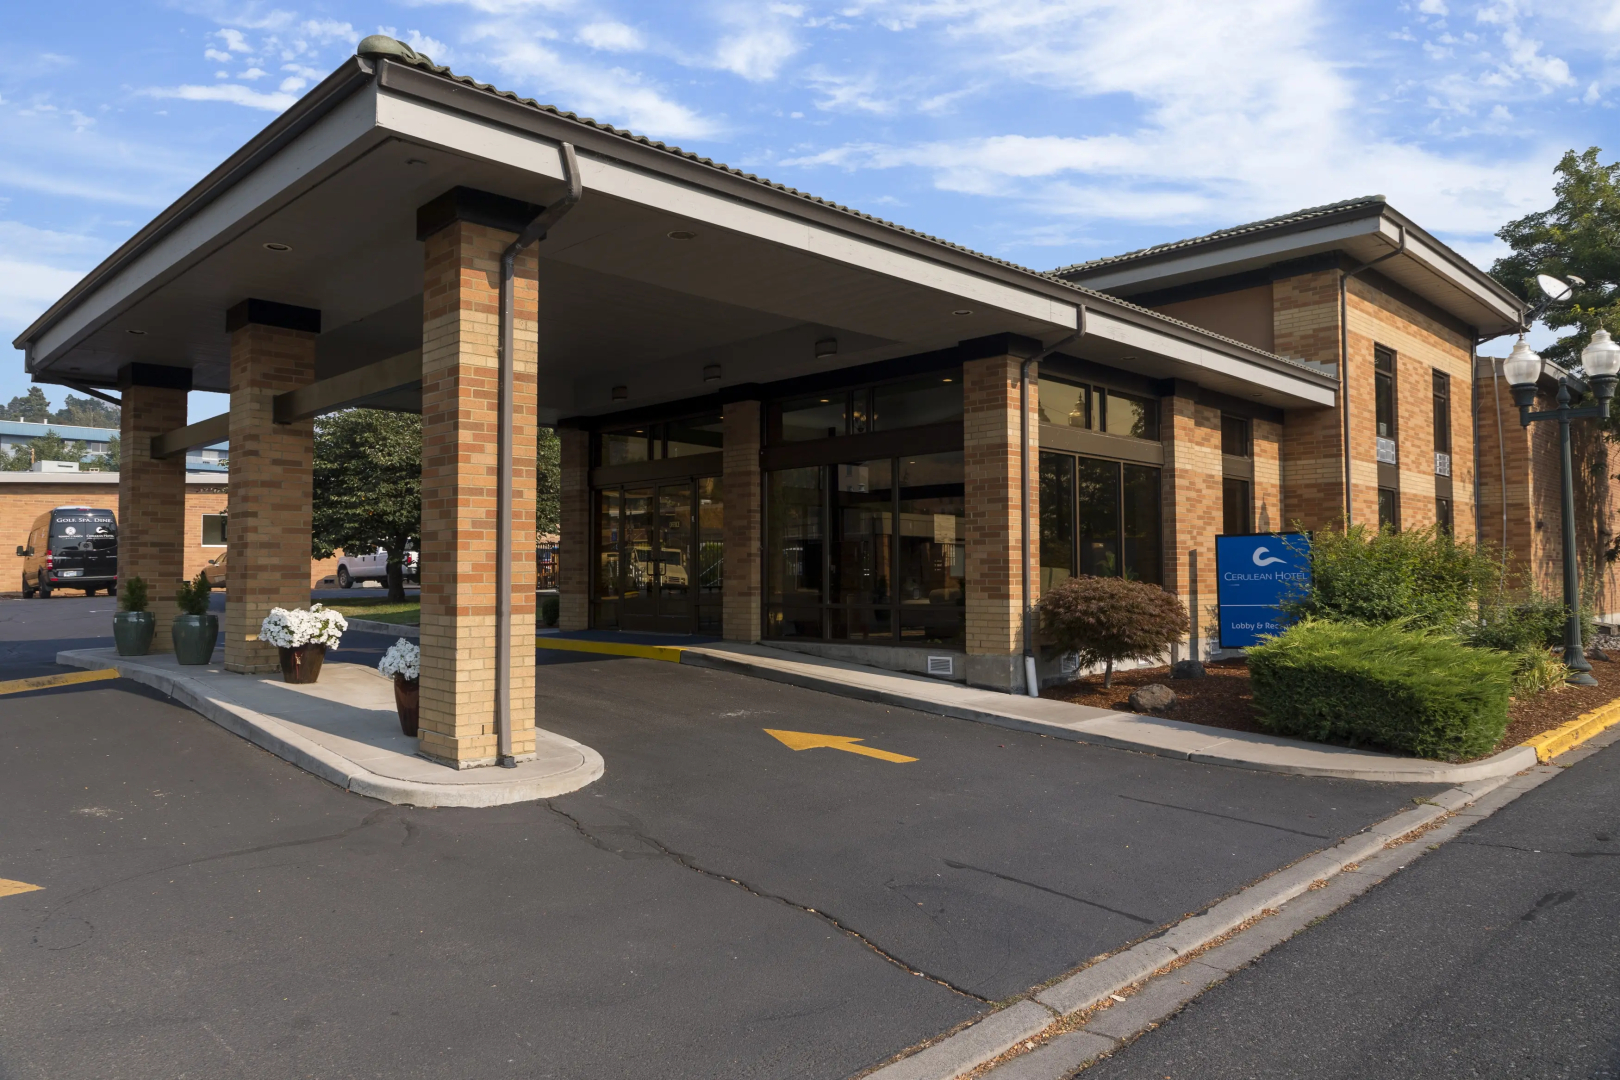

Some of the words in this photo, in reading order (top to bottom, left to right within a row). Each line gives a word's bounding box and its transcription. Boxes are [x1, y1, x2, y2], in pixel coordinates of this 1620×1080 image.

[1224, 572, 1272, 581] CERULEAN
[1231, 622, 1255, 631] Lobby
[1256, 622, 1263, 630] &
